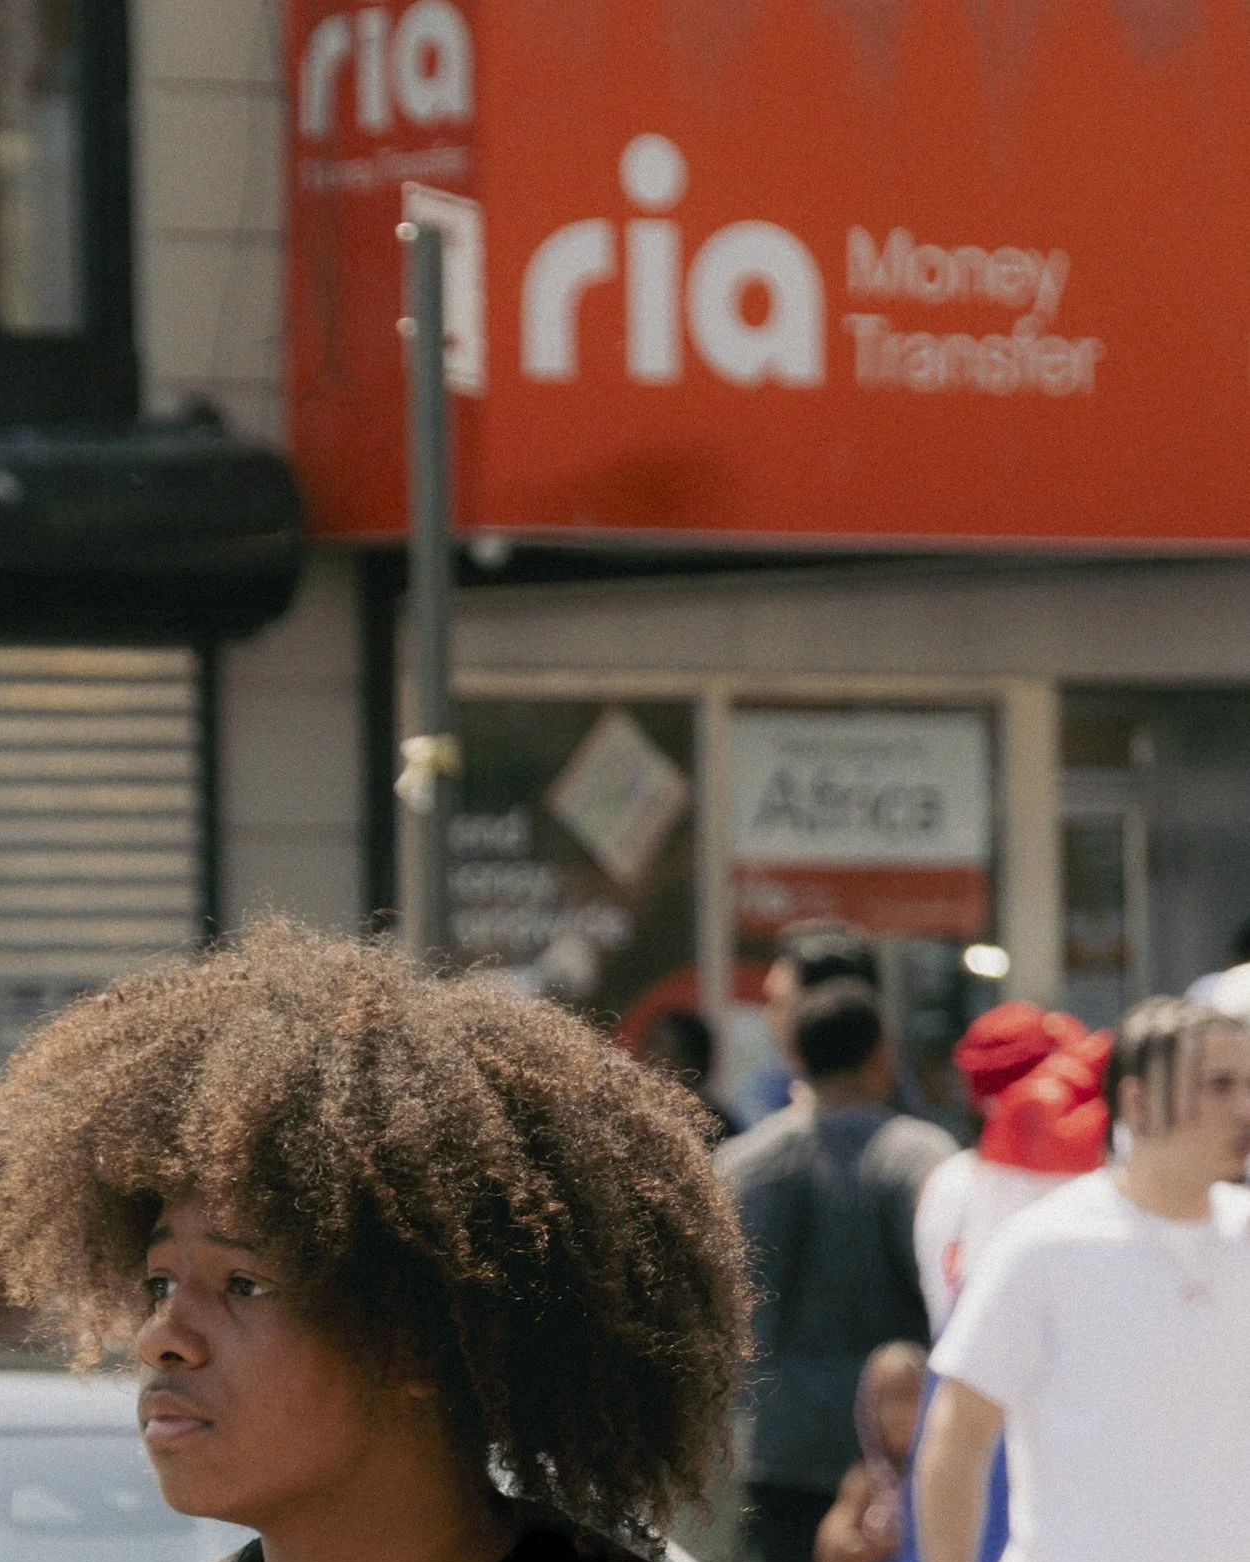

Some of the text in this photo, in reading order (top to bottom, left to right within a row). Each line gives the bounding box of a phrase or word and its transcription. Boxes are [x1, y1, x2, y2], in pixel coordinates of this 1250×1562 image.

[299, 0, 477, 140] ria
[519, 132, 827, 389] ria
[846, 224, 1071, 322] Money
[842, 312, 1106, 396] Transfer
